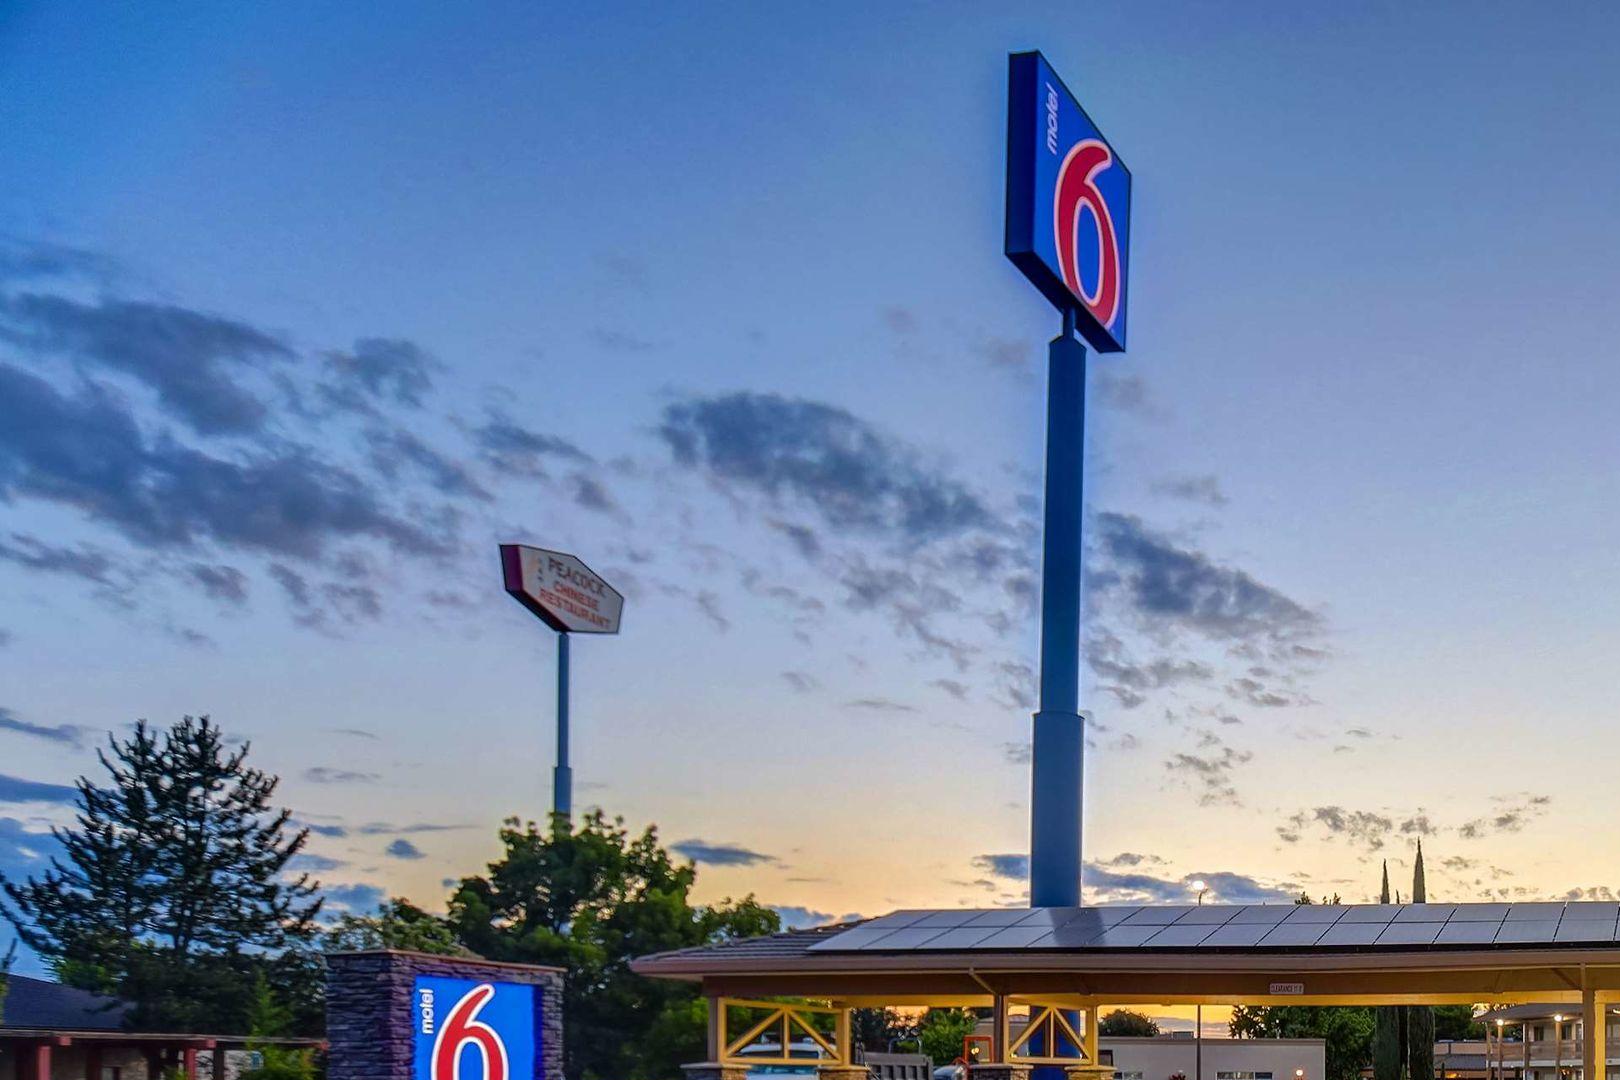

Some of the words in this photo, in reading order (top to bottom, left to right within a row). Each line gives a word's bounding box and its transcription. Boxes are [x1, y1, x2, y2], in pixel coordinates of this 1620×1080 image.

[1045, 82, 1058, 155] motel
[1053, 138, 1119, 329] 6
[419, 988, 434, 1034] motel
